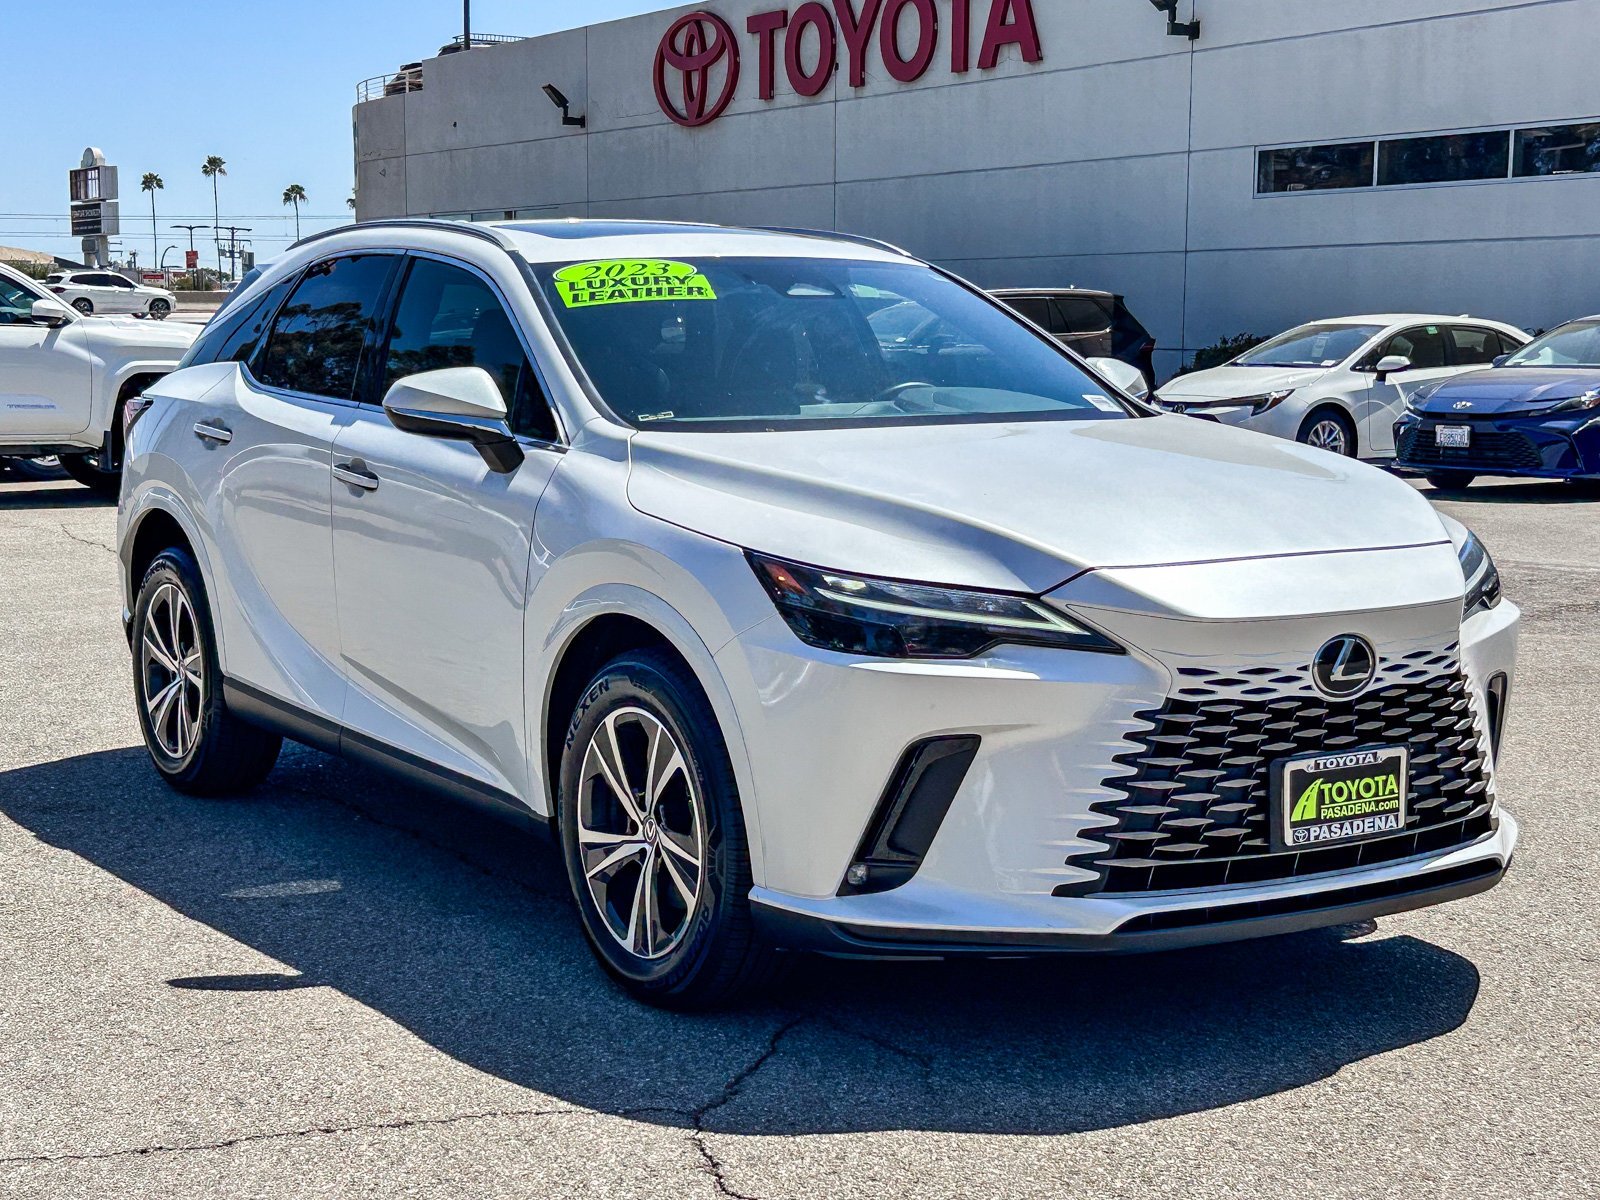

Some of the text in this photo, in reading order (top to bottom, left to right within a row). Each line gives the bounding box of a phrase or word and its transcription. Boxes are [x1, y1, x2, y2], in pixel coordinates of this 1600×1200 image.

[747, 0, 1043, 100] TOYOTA
[582, 263, 671, 280] 2023
[568, 275, 694, 293] LUXURY
[571, 286, 708, 304] LEATHER
[565, 677, 610, 751] NEXEN
[1316, 754, 1375, 770] TOYOTA
[1320, 774, 1399, 805] TOYOTA
[1320, 799, 1399, 820] PASADENA.com
[1309, 815, 1397, 841] PASADENA
